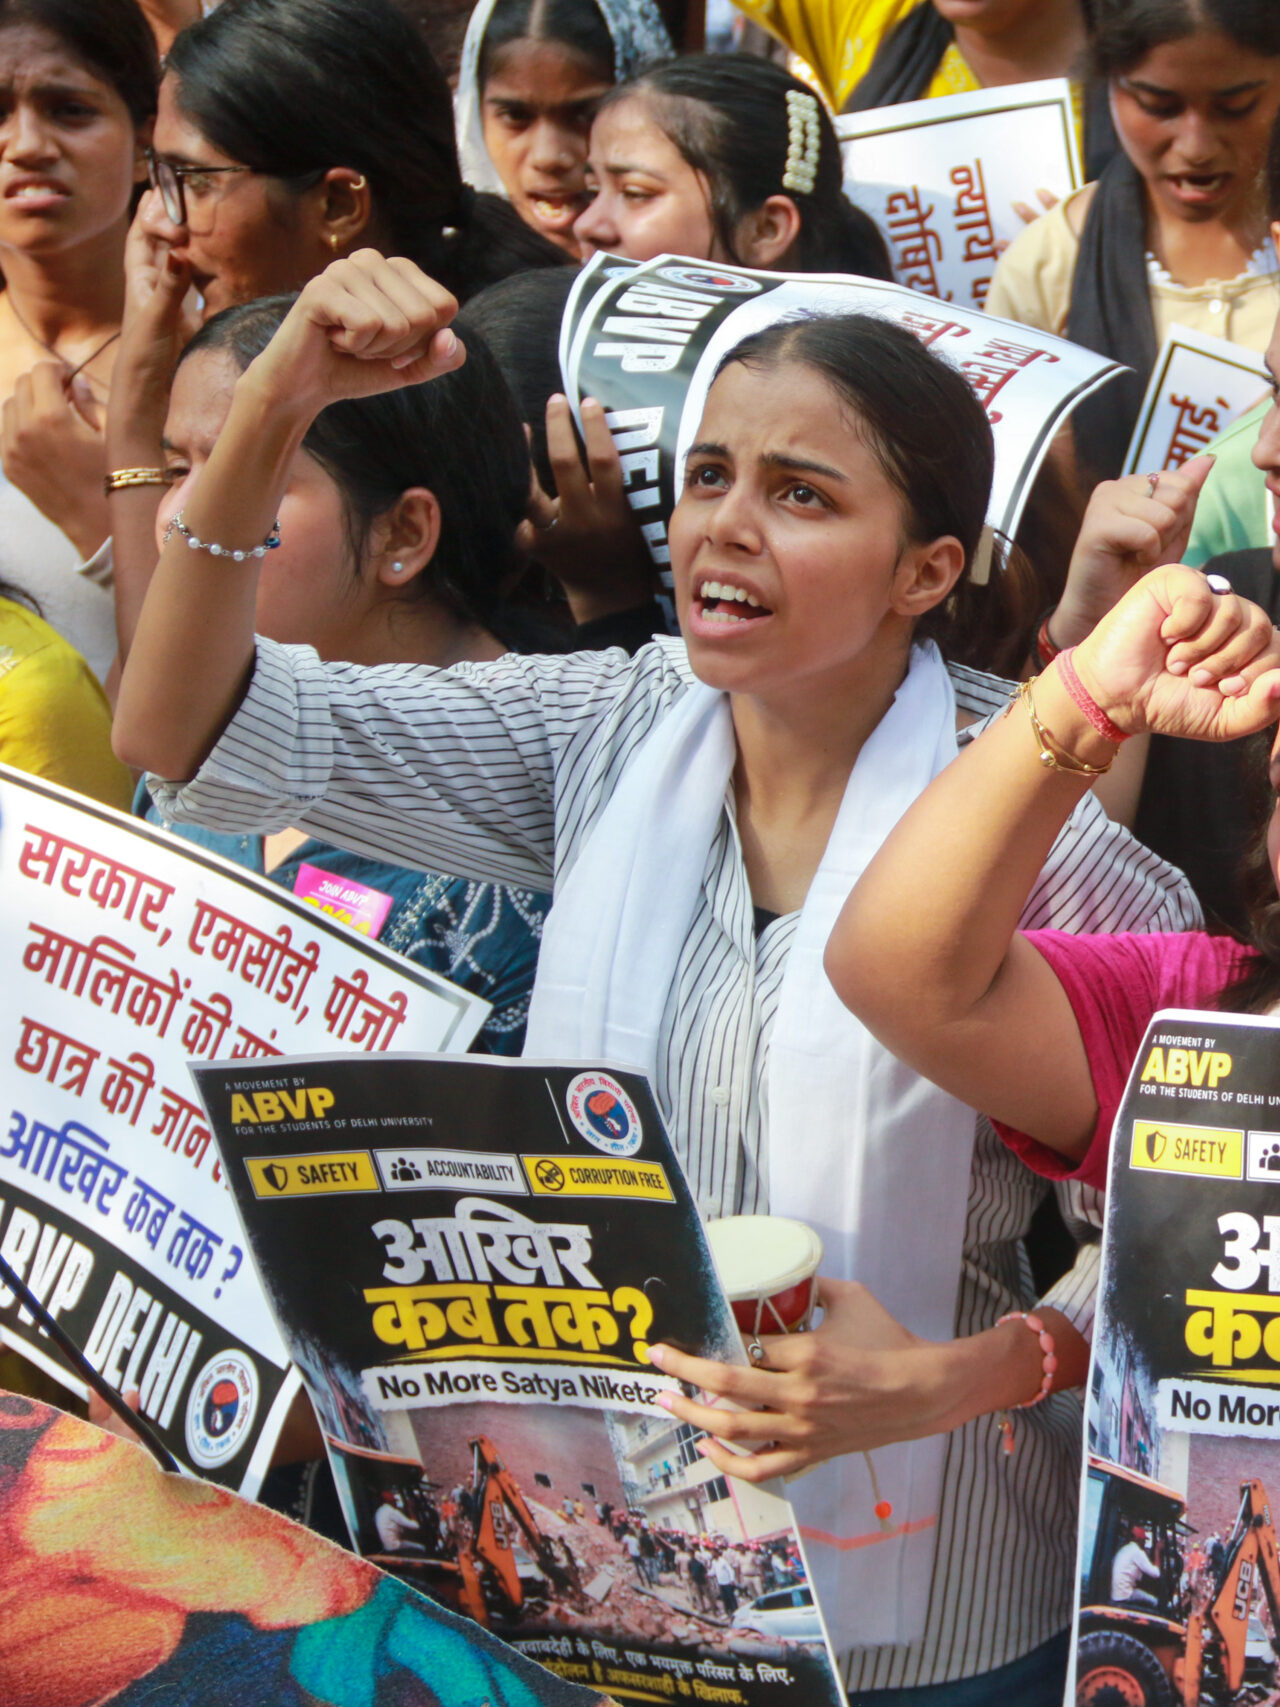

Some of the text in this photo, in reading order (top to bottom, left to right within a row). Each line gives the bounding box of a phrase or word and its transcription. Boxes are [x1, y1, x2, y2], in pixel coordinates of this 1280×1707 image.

[593, 281, 725, 372] ABVP
[319, 881, 343, 897] JOIN
[18, 824, 407, 1051] सरकार, एमसीडी, पीजी
[21, 922, 232, 1060] मालिकों की
[1159, 1035, 1202, 1047] MOVEMENT
[1205, 1038, 1216, 1048] BY
[234, 1078, 289, 1090] MOVEMENT
[292, 1077, 306, 1086] BY
[1140, 1047, 1232, 1088] ABVP
[14, 1017, 212, 1169] छात्र की जान
[231, 1087, 335, 1124] ABVP
[1140, 1084, 1156, 1095] FOR
[1160, 1086, 1176, 1097] THE
[1178, 1088, 1218, 1101] STUDENTS
[1221, 1091, 1233, 1102] OF
[1237, 1093, 1264, 1105] DELHI
[235, 1116, 433, 1136] FOR THE STUDENTS OF DELHI UNIVERSITY
[1174, 1138, 1227, 1164] SAFETY
[297, 1161, 359, 1185] SAFETY
[426, 1160, 516, 1183] ACCOUNTABILITY
[569, 1167, 665, 1190] CORRUPTION FREE
[0, 1110, 128, 1216] आखिर
[122, 1177, 176, 1250] कब
[166, 1210, 223, 1281] तक
[371, 1197, 602, 1288] आखिर
[0, 1198, 95, 1338] BVP
[82, 1271, 203, 1430] DELHI
[363, 1283, 655, 1365] कब तक?
[377, 1370, 663, 1406] No More Satya Niketa
[1171, 1389, 1211, 1421] No
[1234, 1559, 1252, 1620] JCB
[738, 1662, 754, 1682] के
